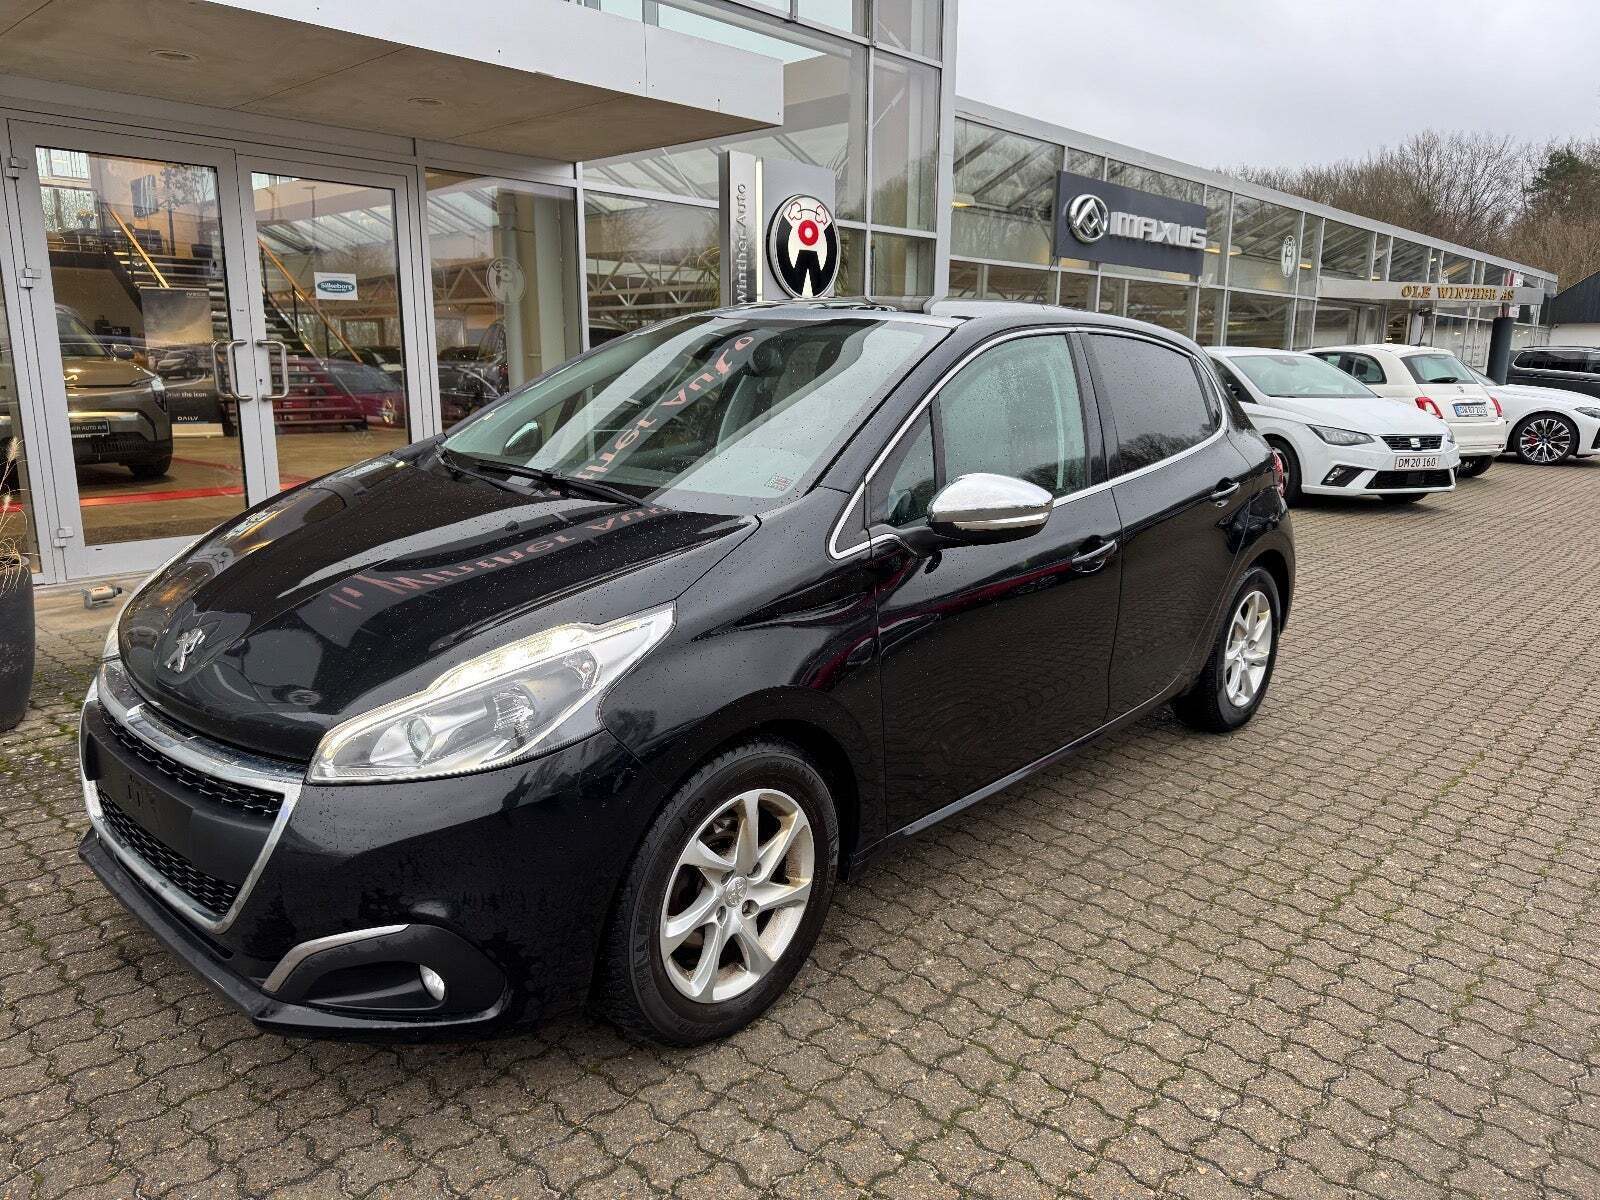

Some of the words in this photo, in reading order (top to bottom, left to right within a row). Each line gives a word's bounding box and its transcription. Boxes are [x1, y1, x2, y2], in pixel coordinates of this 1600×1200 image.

[735, 184, 748, 228] Auto
[1109, 211, 1207, 250] MAXUS
[735, 233, 748, 305] Winther
[1401, 285, 1431, 299] OLE
[1437, 287, 1497, 300] WINTHER
[1422, 457, 1436, 467] 160
